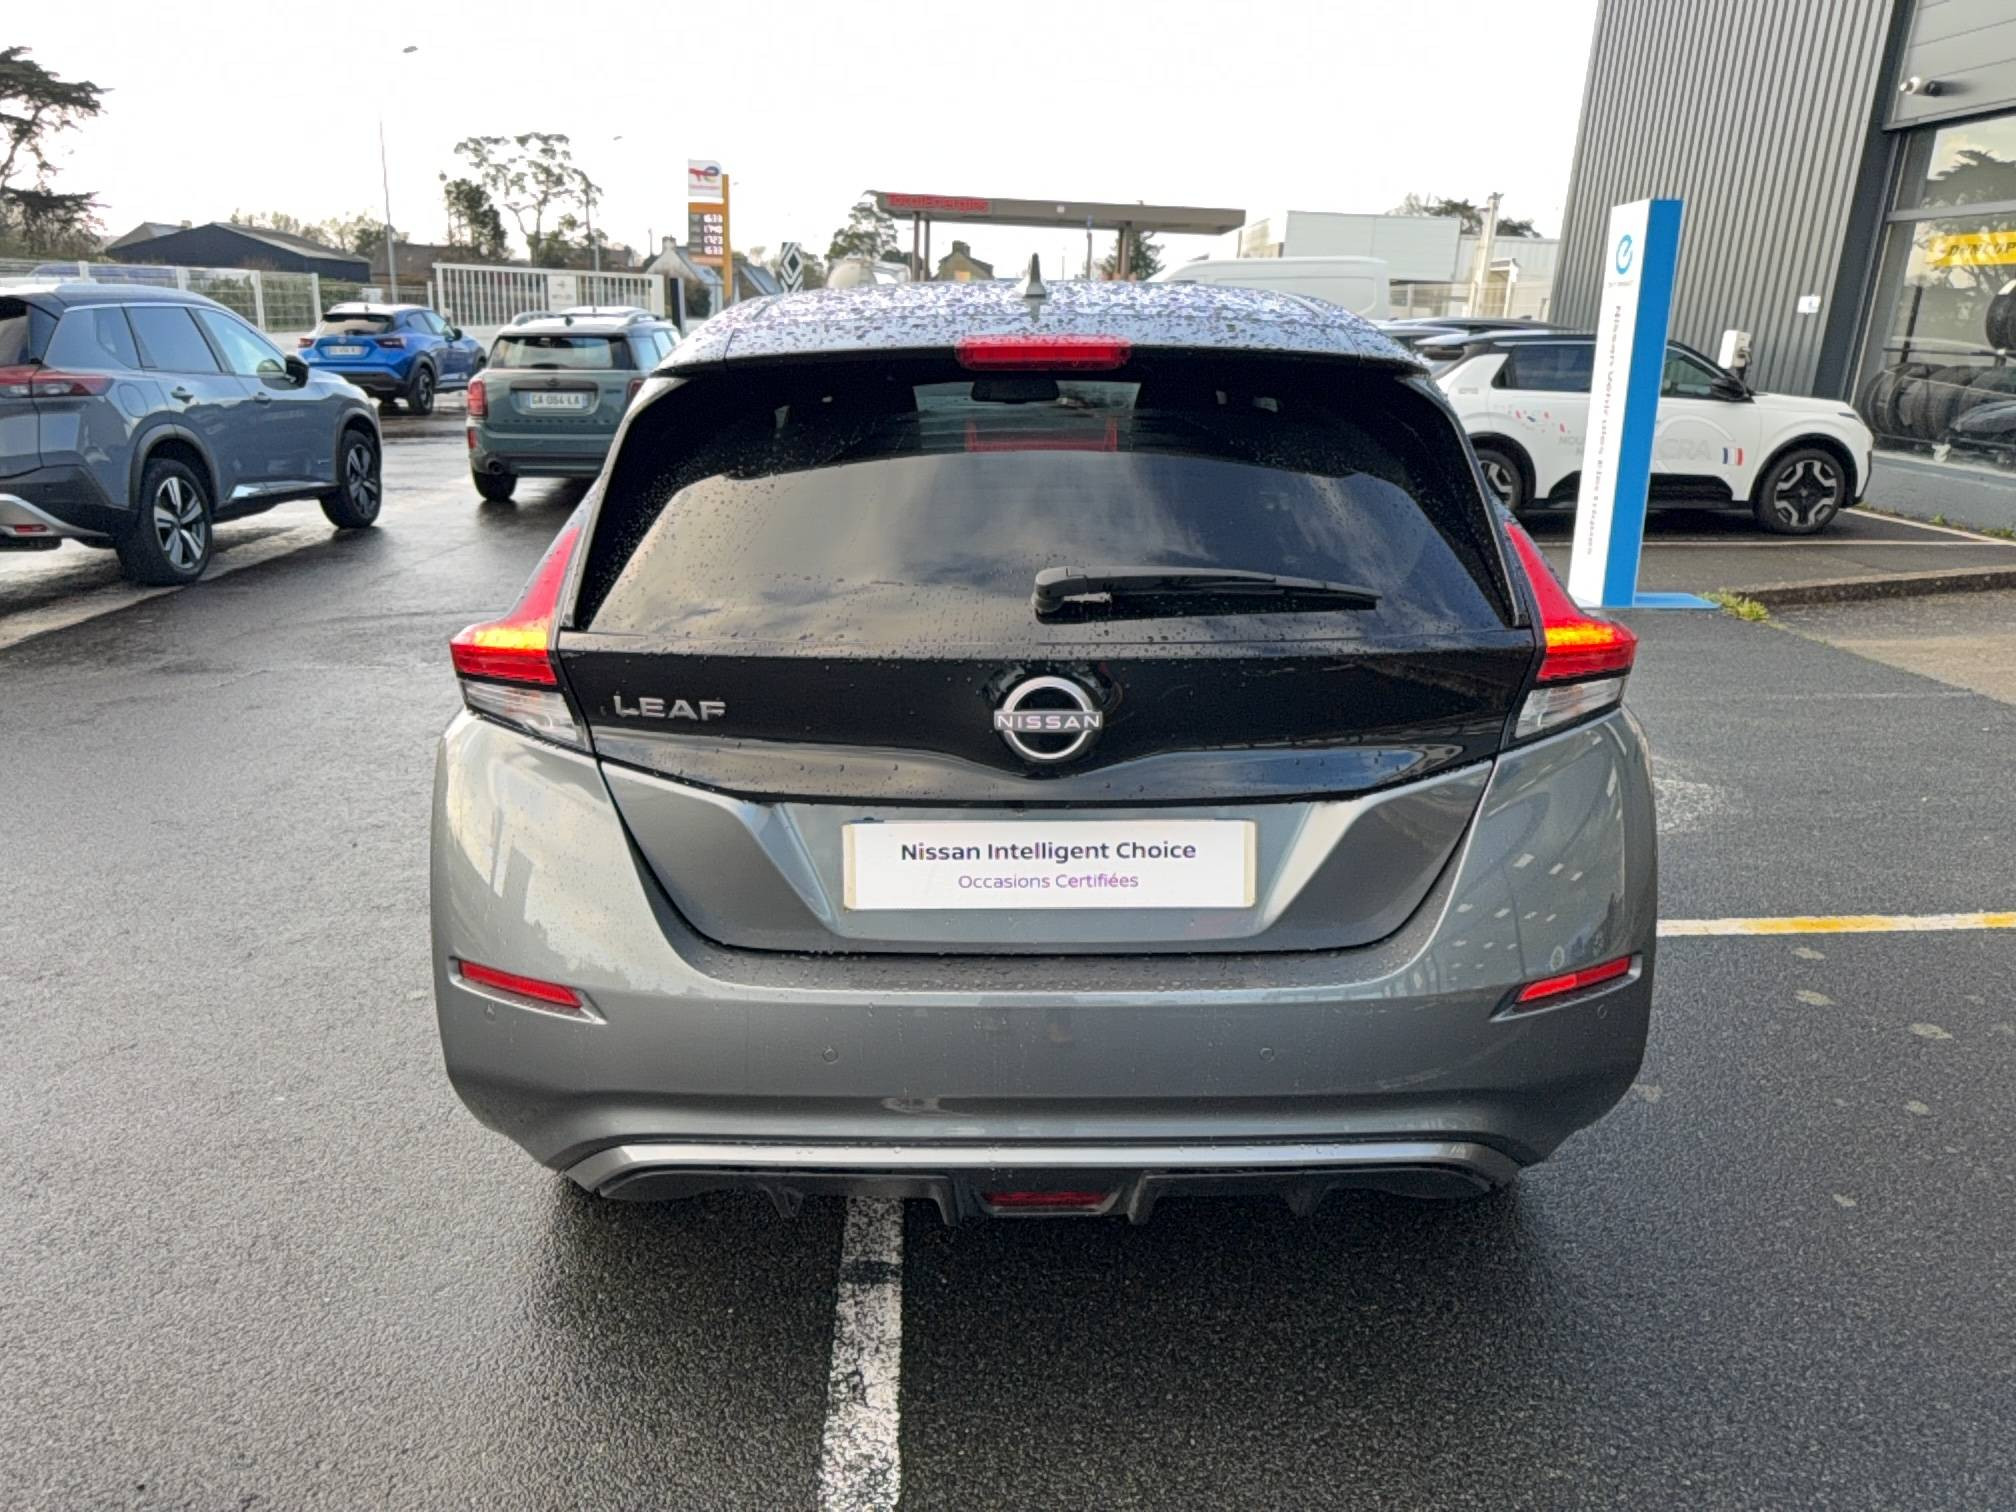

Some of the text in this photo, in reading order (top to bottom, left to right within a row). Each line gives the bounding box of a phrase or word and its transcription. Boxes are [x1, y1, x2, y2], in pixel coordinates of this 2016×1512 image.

[613, 695, 726, 720] LEAF
[997, 714, 1100, 730] NISSAN
[901, 840, 1197, 864] Nissan Intelligent Choice
[957, 871, 1139, 889] Occasions Certifiées
